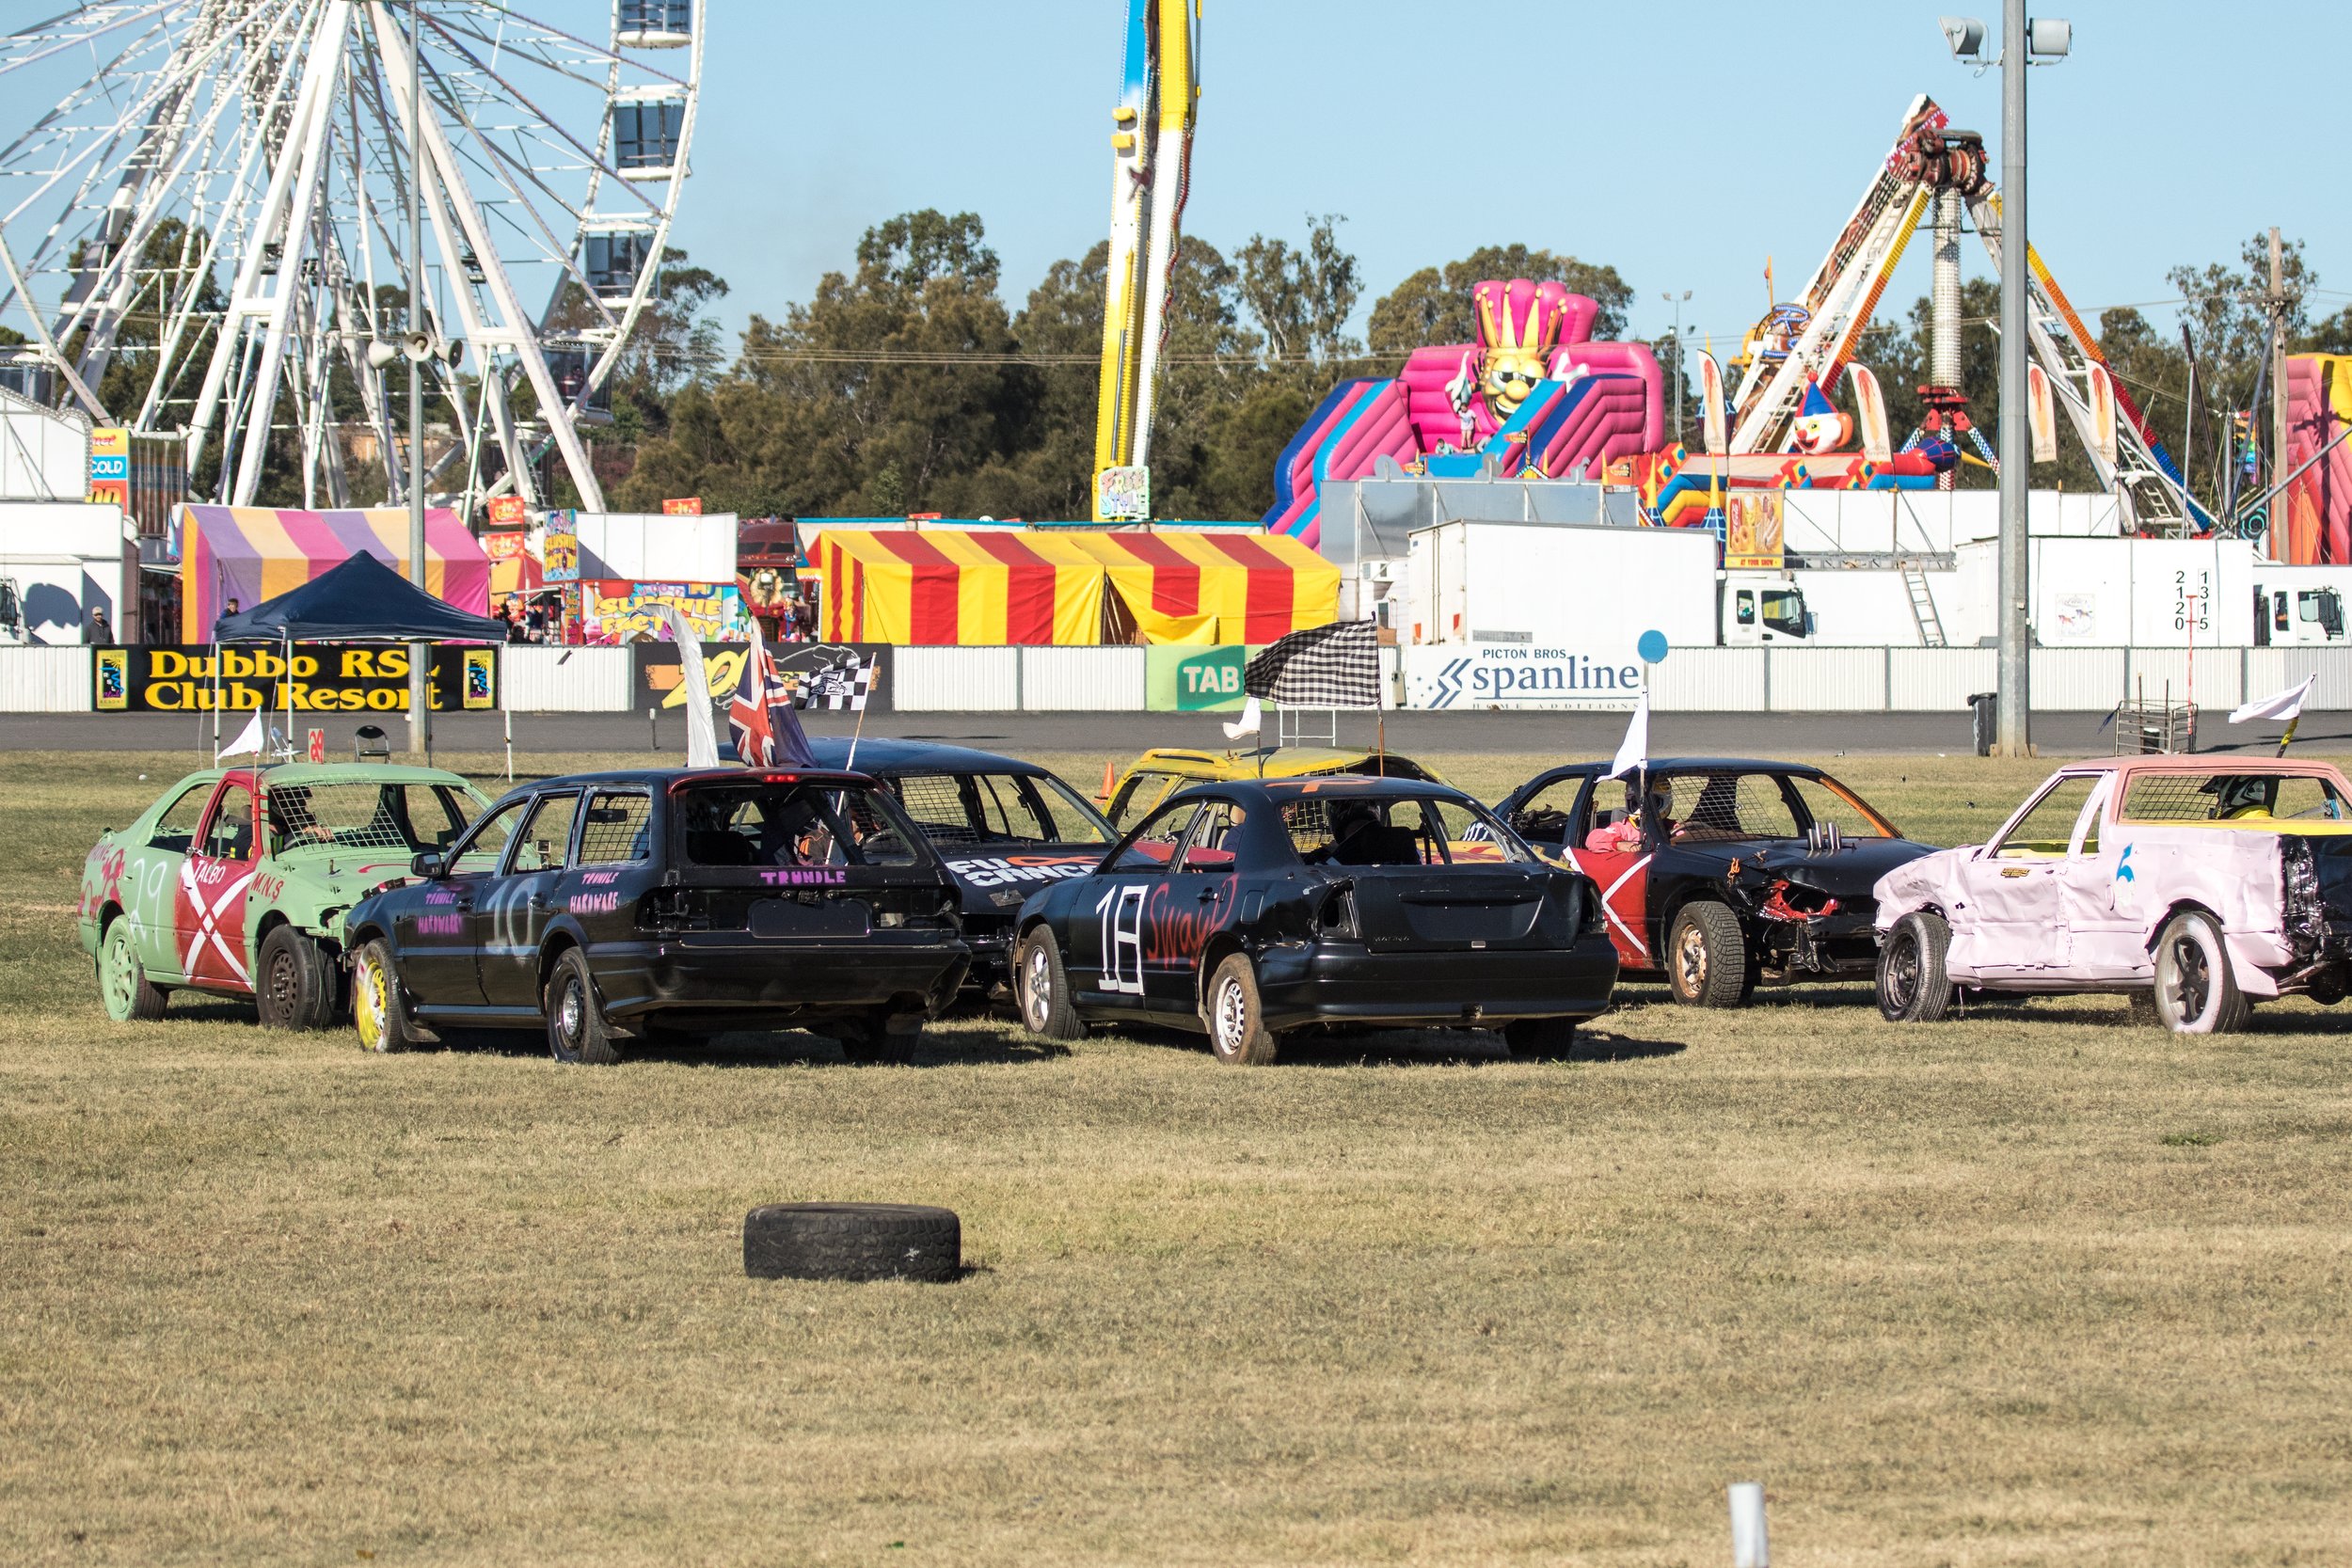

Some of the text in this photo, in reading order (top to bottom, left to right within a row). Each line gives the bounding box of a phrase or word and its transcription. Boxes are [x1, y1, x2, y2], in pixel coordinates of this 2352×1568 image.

[598, 595, 723, 616] SLUSHIE
[601, 615, 723, 637] FACTRY
[149, 650, 319, 678] Dubbo
[1483, 649, 1527, 658] PICTON
[1183, 666, 1240, 692] TAB
[1472, 656, 1639, 699] spanline
[144, 681, 263, 710] Club
[760, 870, 846, 885] TRUNDLE
[129, 857, 168, 953] 29
[569, 891, 619, 914] HARDWARE
[1095, 884, 1150, 995] 18
